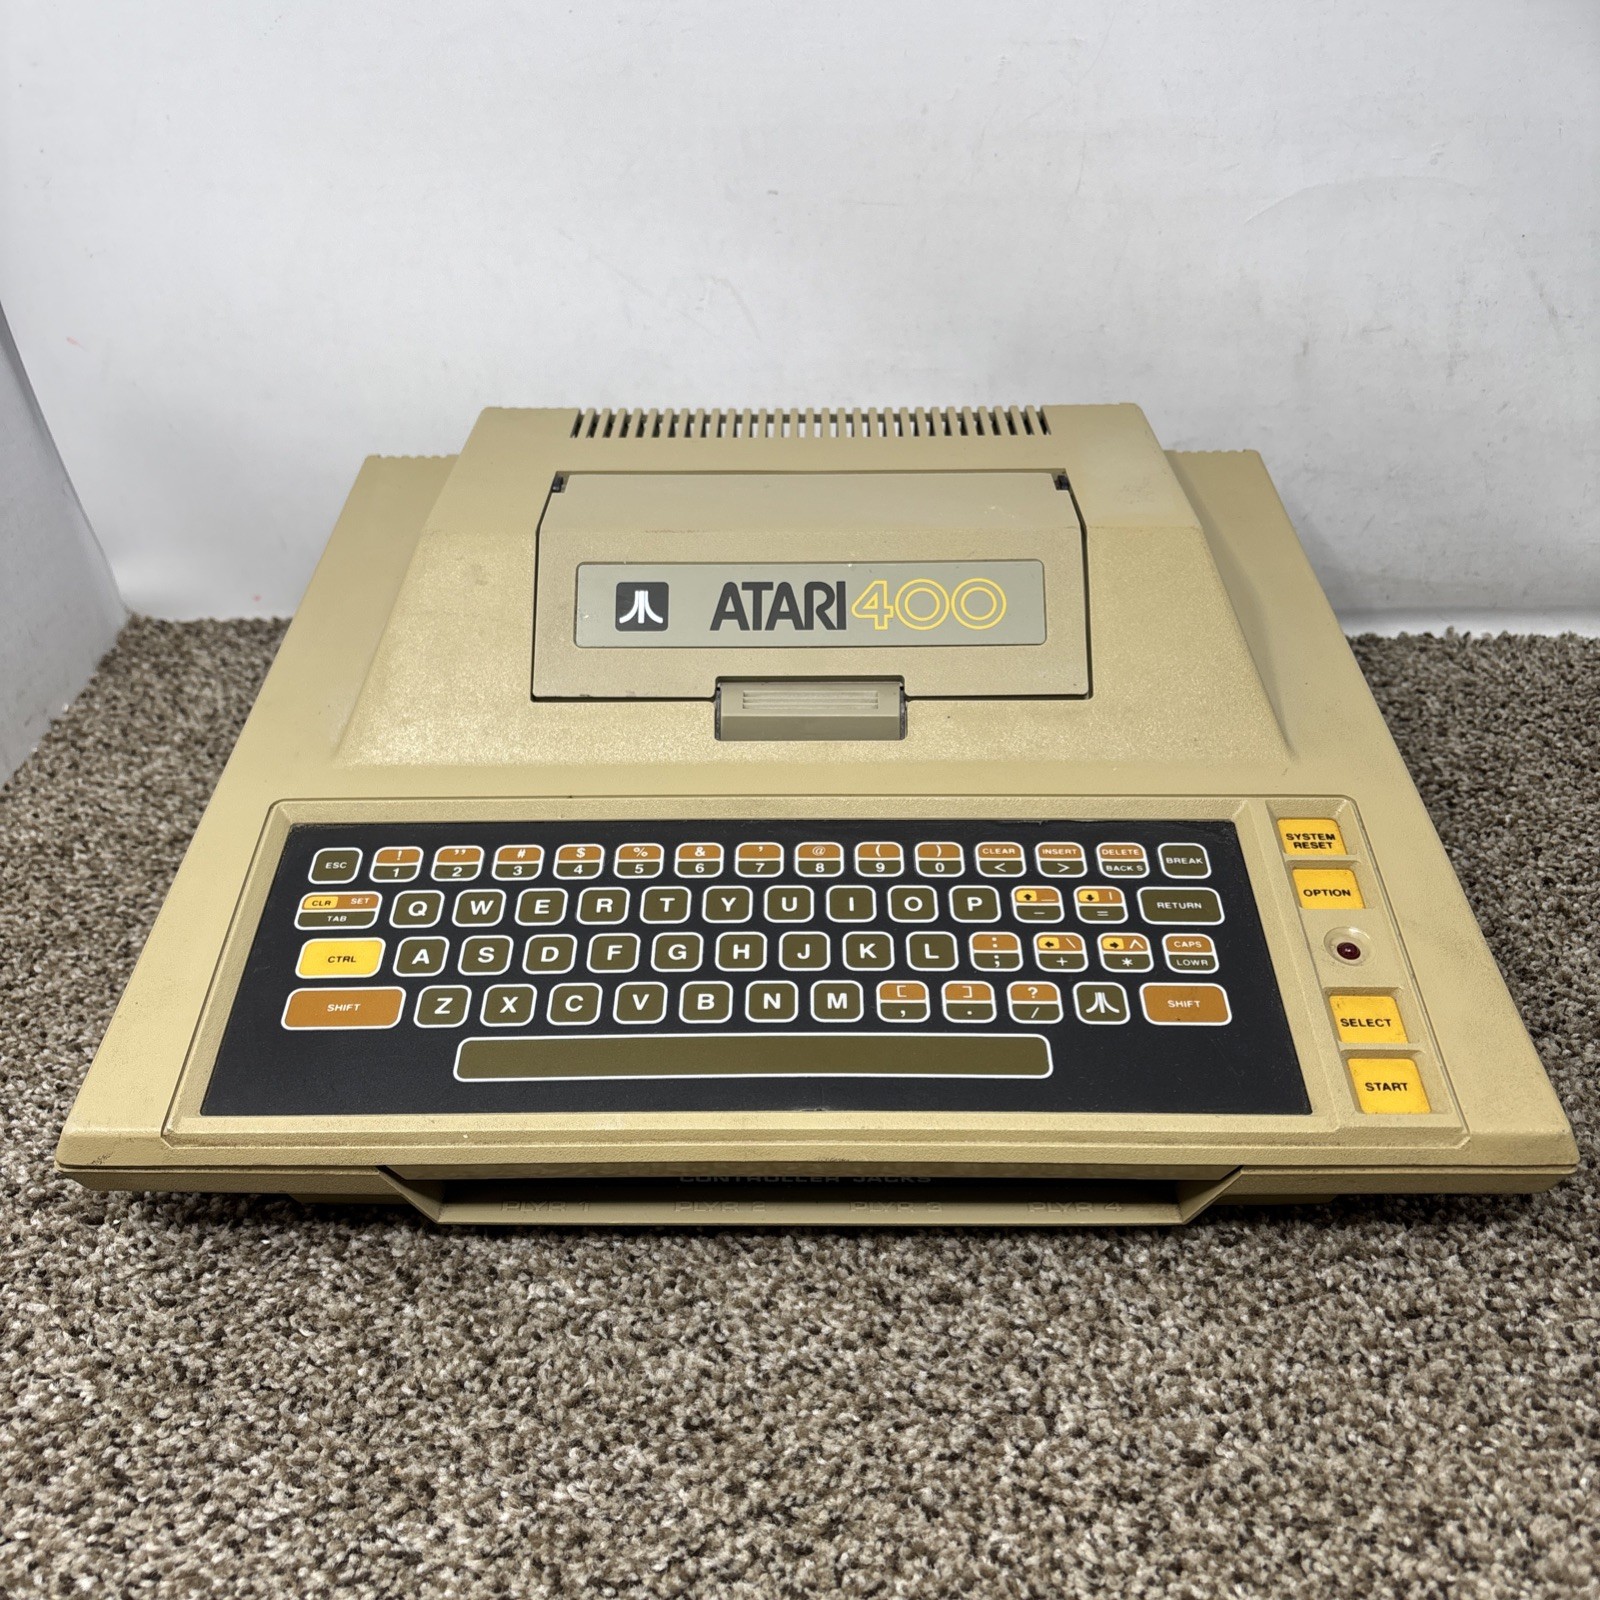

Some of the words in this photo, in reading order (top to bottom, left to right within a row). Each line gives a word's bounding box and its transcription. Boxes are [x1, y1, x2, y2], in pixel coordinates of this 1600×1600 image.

[710, 580, 847, 631] ATARI
[851, 577, 1007, 631] 400
[1285, 833, 1336, 841] SYSTEM
[812, 846, 826, 856] @
[875, 844, 881, 857] (
[936, 844, 942, 857] )
[1293, 841, 1333, 850] RESET
[396, 850, 403, 861] !
[516, 849, 526, 859] #
[576, 847, 586, 859] $
[633, 847, 648, 858] %
[694, 846, 706, 857] &
[1101, 848, 1140, 856] DELETE
[325, 861, 347, 870] ESC
[1165, 857, 1203, 865] BREAK
[392, 867, 400, 878] 1
[451, 866, 463, 877] 2
[513, 866, 523, 876] 3
[573, 865, 584, 875] 4
[634, 863, 644, 874] 5
[695, 863, 705, 874] 6
[755, 862, 765, 873] 7
[815, 862, 825, 873] 8
[875, 862, 885, 873] 9
[935, 862, 945, 873] 0
[994, 863, 1007, 872] <
[1057, 863, 1070, 872] >
[1106, 864, 1134, 872] BACK
[1136, 864, 1143, 872] S
[1303, 888, 1351, 897] OPTION
[312, 899, 332, 907] CLR
[350, 897, 370, 905] SET
[534, 899, 550, 914] E
[596, 898, 614, 913] R
[659, 897, 675, 913] T
[721, 897, 736, 912] Y
[781, 897, 798, 912] U
[848, 897, 855, 912] I
[904, 896, 923, 912] O
[967, 896, 983, 912] P
[1156, 902, 1202, 910] RETURN
[408, 901, 428, 917] Q
[470, 900, 493, 915] W
[1173, 940, 1202, 949] CAPS
[477, 947, 495, 963] S
[540, 947, 559, 963] D
[607, 945, 623, 960] F
[668, 944, 687, 960] G
[733, 944, 750, 960] H
[797, 944, 810, 960] J
[859, 943, 877, 959] K
[924, 943, 940, 959] L
[327, 955, 356, 963] CTRL
[412, 949, 430, 965] A
[1056, 957, 1068, 966] +
[1176, 959, 1209, 967] LOWR
[1027, 986, 1038, 999] ?
[434, 997, 453, 1014] Z
[499, 996, 519, 1014] X
[565, 995, 584, 1012] C
[632, 994, 650, 1011] V
[697, 993, 715, 1010] B
[763, 992, 781, 1010] N
[827, 992, 847, 1010] M
[1167, 999, 1201, 1009] SHIFT
[327, 1003, 361, 1012] SHIFT
[1340, 1018, 1392, 1028] SELECT
[1364, 1082, 1408, 1092] START
[501, 1201, 567, 1212] PLYR
[675, 1201, 739, 1212] PLYR
[751, 1201, 766, 1212] 2
[850, 1201, 915, 1212] PLYR
[927, 1202, 942, 1212] 3
[1028, 1201, 1094, 1213] PLYR
[1105, 1202, 1123, 1212] 4
